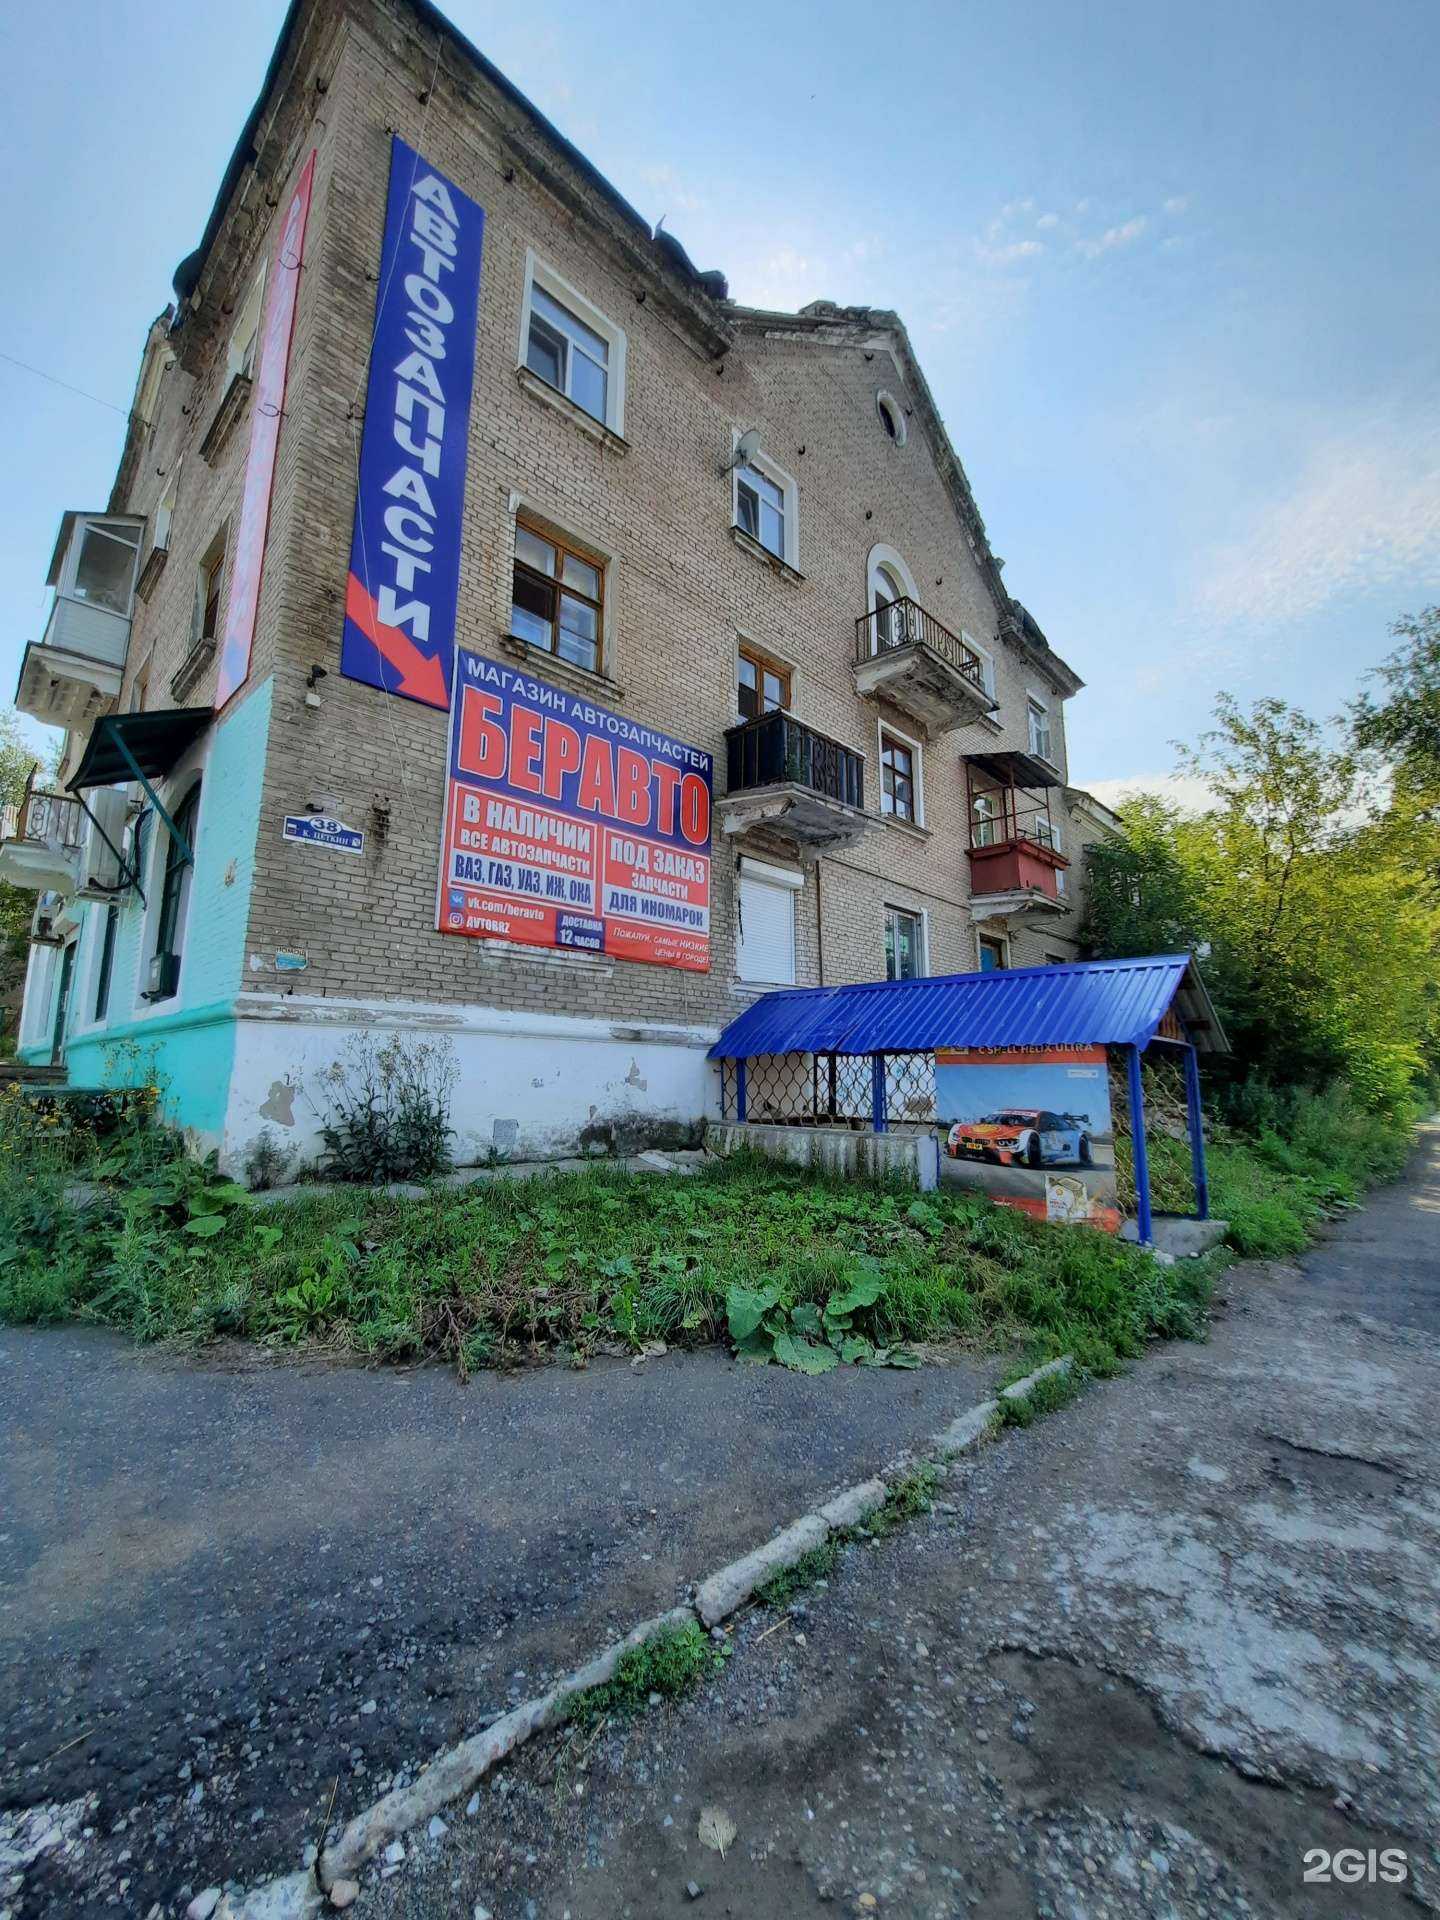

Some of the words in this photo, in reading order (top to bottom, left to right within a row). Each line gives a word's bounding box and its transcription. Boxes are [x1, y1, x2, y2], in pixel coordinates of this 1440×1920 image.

[376, 174, 460, 643] АВТОЗАПЧАСТИ
[468, 658, 566, 713] МАГАЗИН
[571, 702, 708, 771] АВТОЗАПЧАСТЕЙ
[458, 684, 709, 845] БЕРАВТО
[313, 819, 337, 832] 38
[314, 832, 348, 846] ЦЕТКИН
[463, 793, 480, 823] В
[486, 799, 590, 853] НАЛИЧИИ
[460, 828, 488, 850] ВСЕ
[491, 836, 590, 875] АВТОЗАПЧАСТИ
[610, 836, 649, 873] ПОД
[653, 848, 705, 884] ЗАКАЗ
[454, 854, 485, 884] ВАЗ,
[488, 861, 514, 890] ГАЗ,
[517, 867, 543, 896] УАЗ,
[546, 874, 567, 901] ИЖ,
[569, 879, 591, 904] ОКА
[631, 871, 688, 900] ЗАПЧАСТИ
[467, 897, 545, 921] vk.com/beravto
[562, 915, 603, 932] ДОСТАВКА
[609, 891, 637, 912] ДЛЯ
[641, 899, 703, 927] ИНОМАРОК
[560, 928, 573, 944] 12
[574, 935, 600, 949] ЧАСОВ
